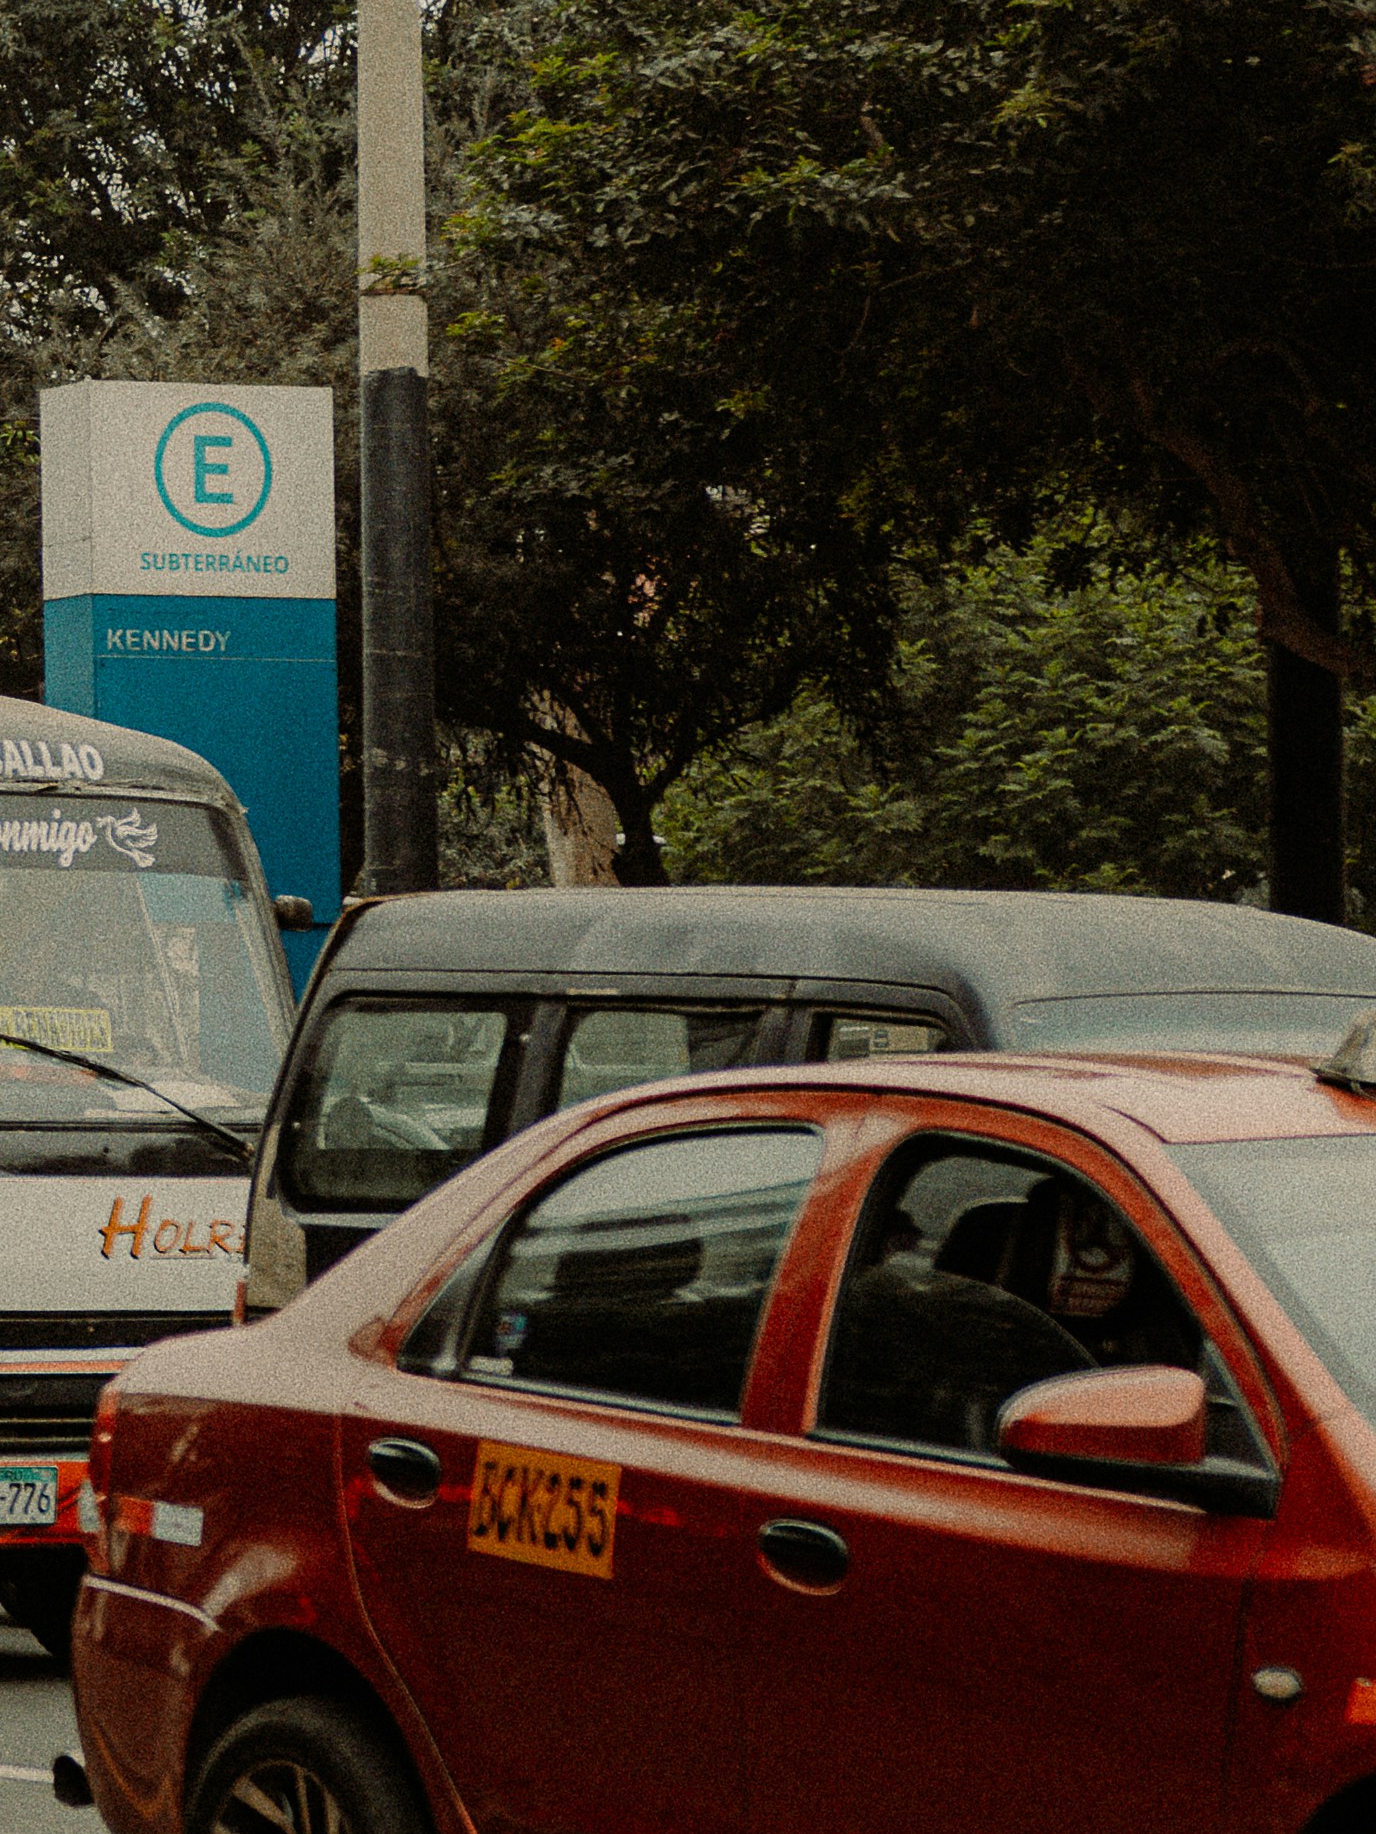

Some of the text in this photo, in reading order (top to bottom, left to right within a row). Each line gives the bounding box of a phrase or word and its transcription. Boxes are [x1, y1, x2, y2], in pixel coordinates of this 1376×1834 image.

[194, 435, 233, 504] E
[140, 549, 289, 574] SUBTERRÁNEO
[106, 628, 231, 652] KENNEDY
